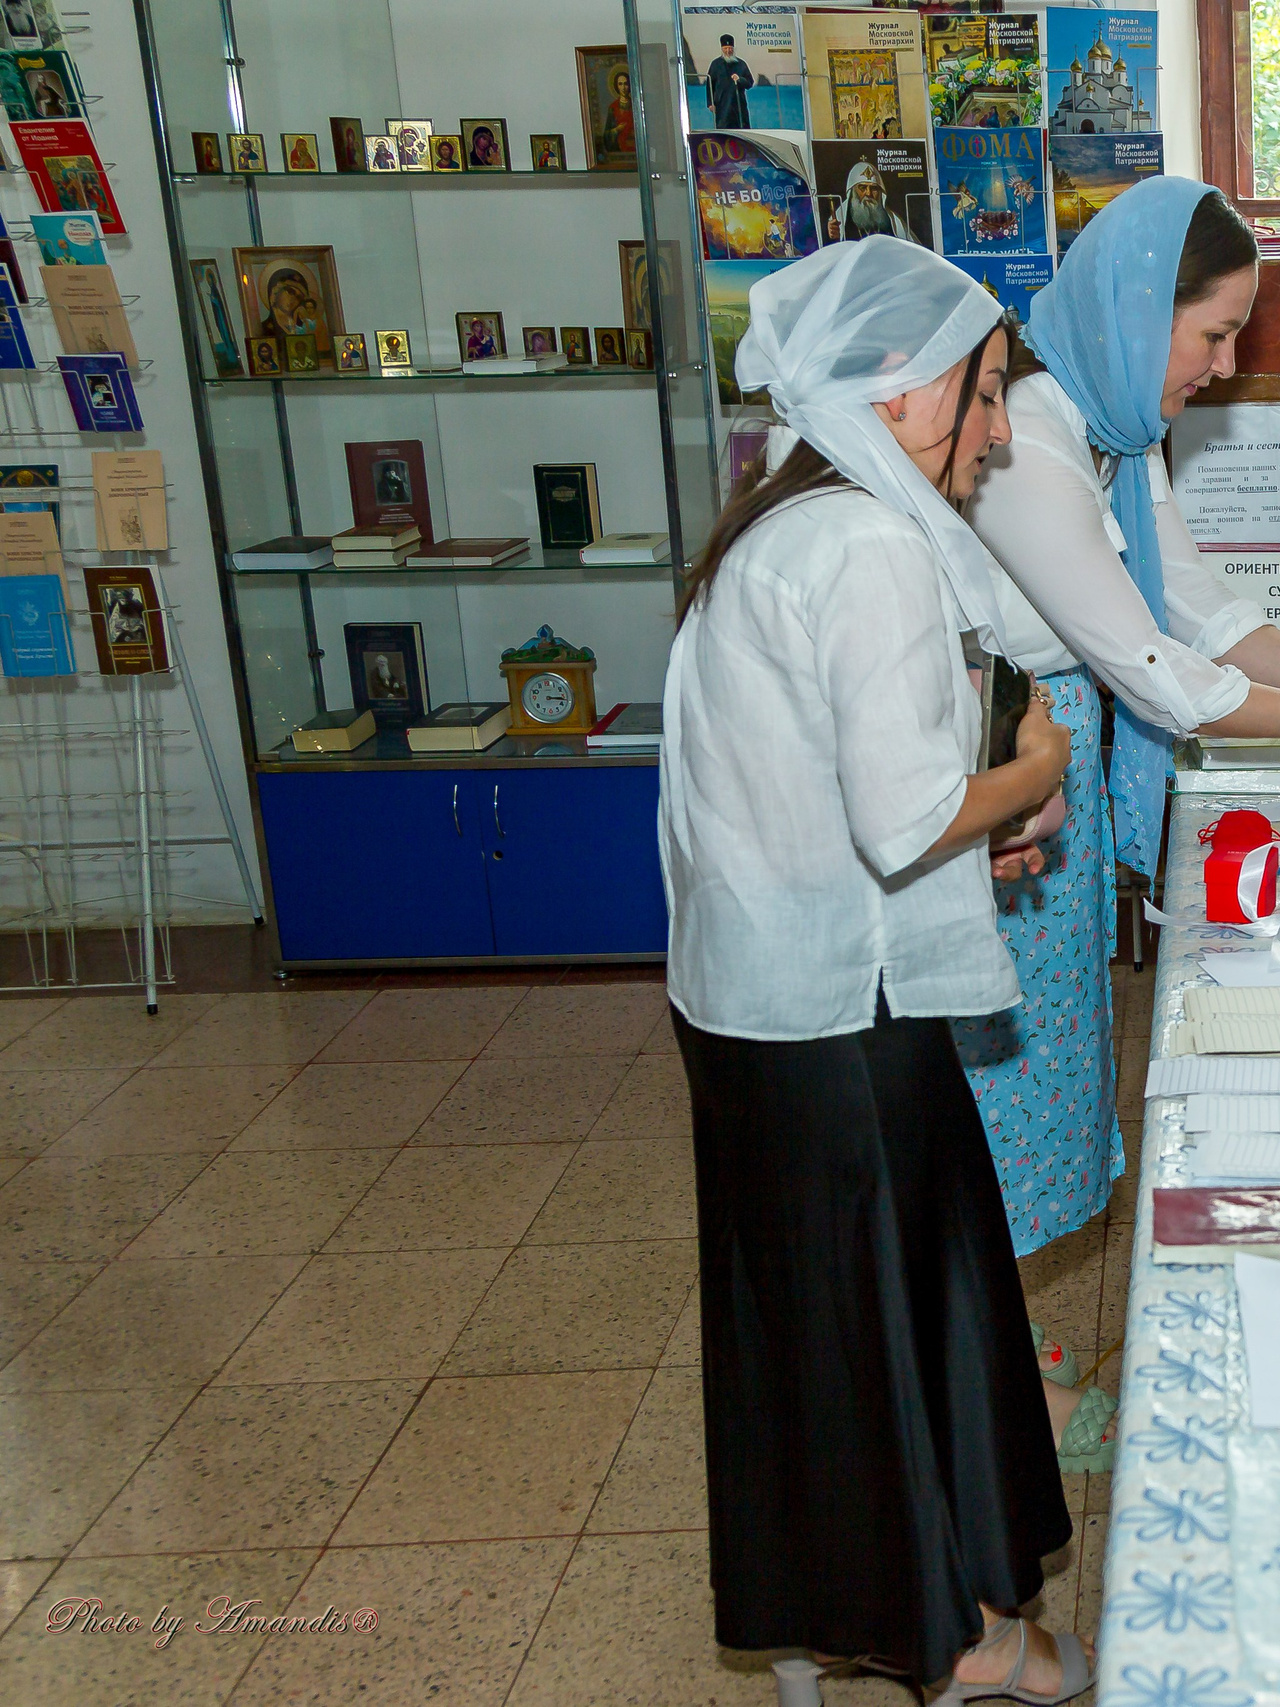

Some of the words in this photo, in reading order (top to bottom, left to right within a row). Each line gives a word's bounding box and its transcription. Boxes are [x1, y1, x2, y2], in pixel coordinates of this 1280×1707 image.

[989, 22, 1020, 30] Журнал
[1109, 17, 1139, 26] Журнал
[746, 22, 776, 31] Журнал
[868, 22, 899, 31] Журнал
[1108, 25, 1153, 34] Московской
[746, 30, 791, 38] Московской
[869, 30, 914, 38] Московской
[989, 29, 1034, 37] Московской
[1108, 33, 1153, 42] Патриархии
[747, 38, 792, 46] Патриархии
[869, 38, 914, 46] Патриархии
[989, 37, 1034, 46] Патриархии
[942, 132, 1035, 162] ФОМА
[1115, 142, 1145, 152] Журнал
[877, 149, 907, 158] Журнал
[1115, 149, 1159, 158] Московской
[877, 156, 922, 164] Московской
[1115, 157, 1159, 166] Патриархии
[877, 163, 922, 172] Патриархии
[715, 190, 737, 205] НЕ
[740, 184, 796, 203] БОЙСЯ
[1005, 263, 1035, 272] Журнал
[1005, 269, 1049, 278] Московской
[1005, 276, 1050, 285] Патриархии
[1204, 442, 1244, 454] Братья
[1247, 443, 1253, 451] и
[1185, 486, 1236, 495] совершаются
[1237, 484, 1280, 494] бесплатно.
[1199, 506, 1247, 515] Пожалуйста,
[1190, 526, 1222, 536] аписках.
